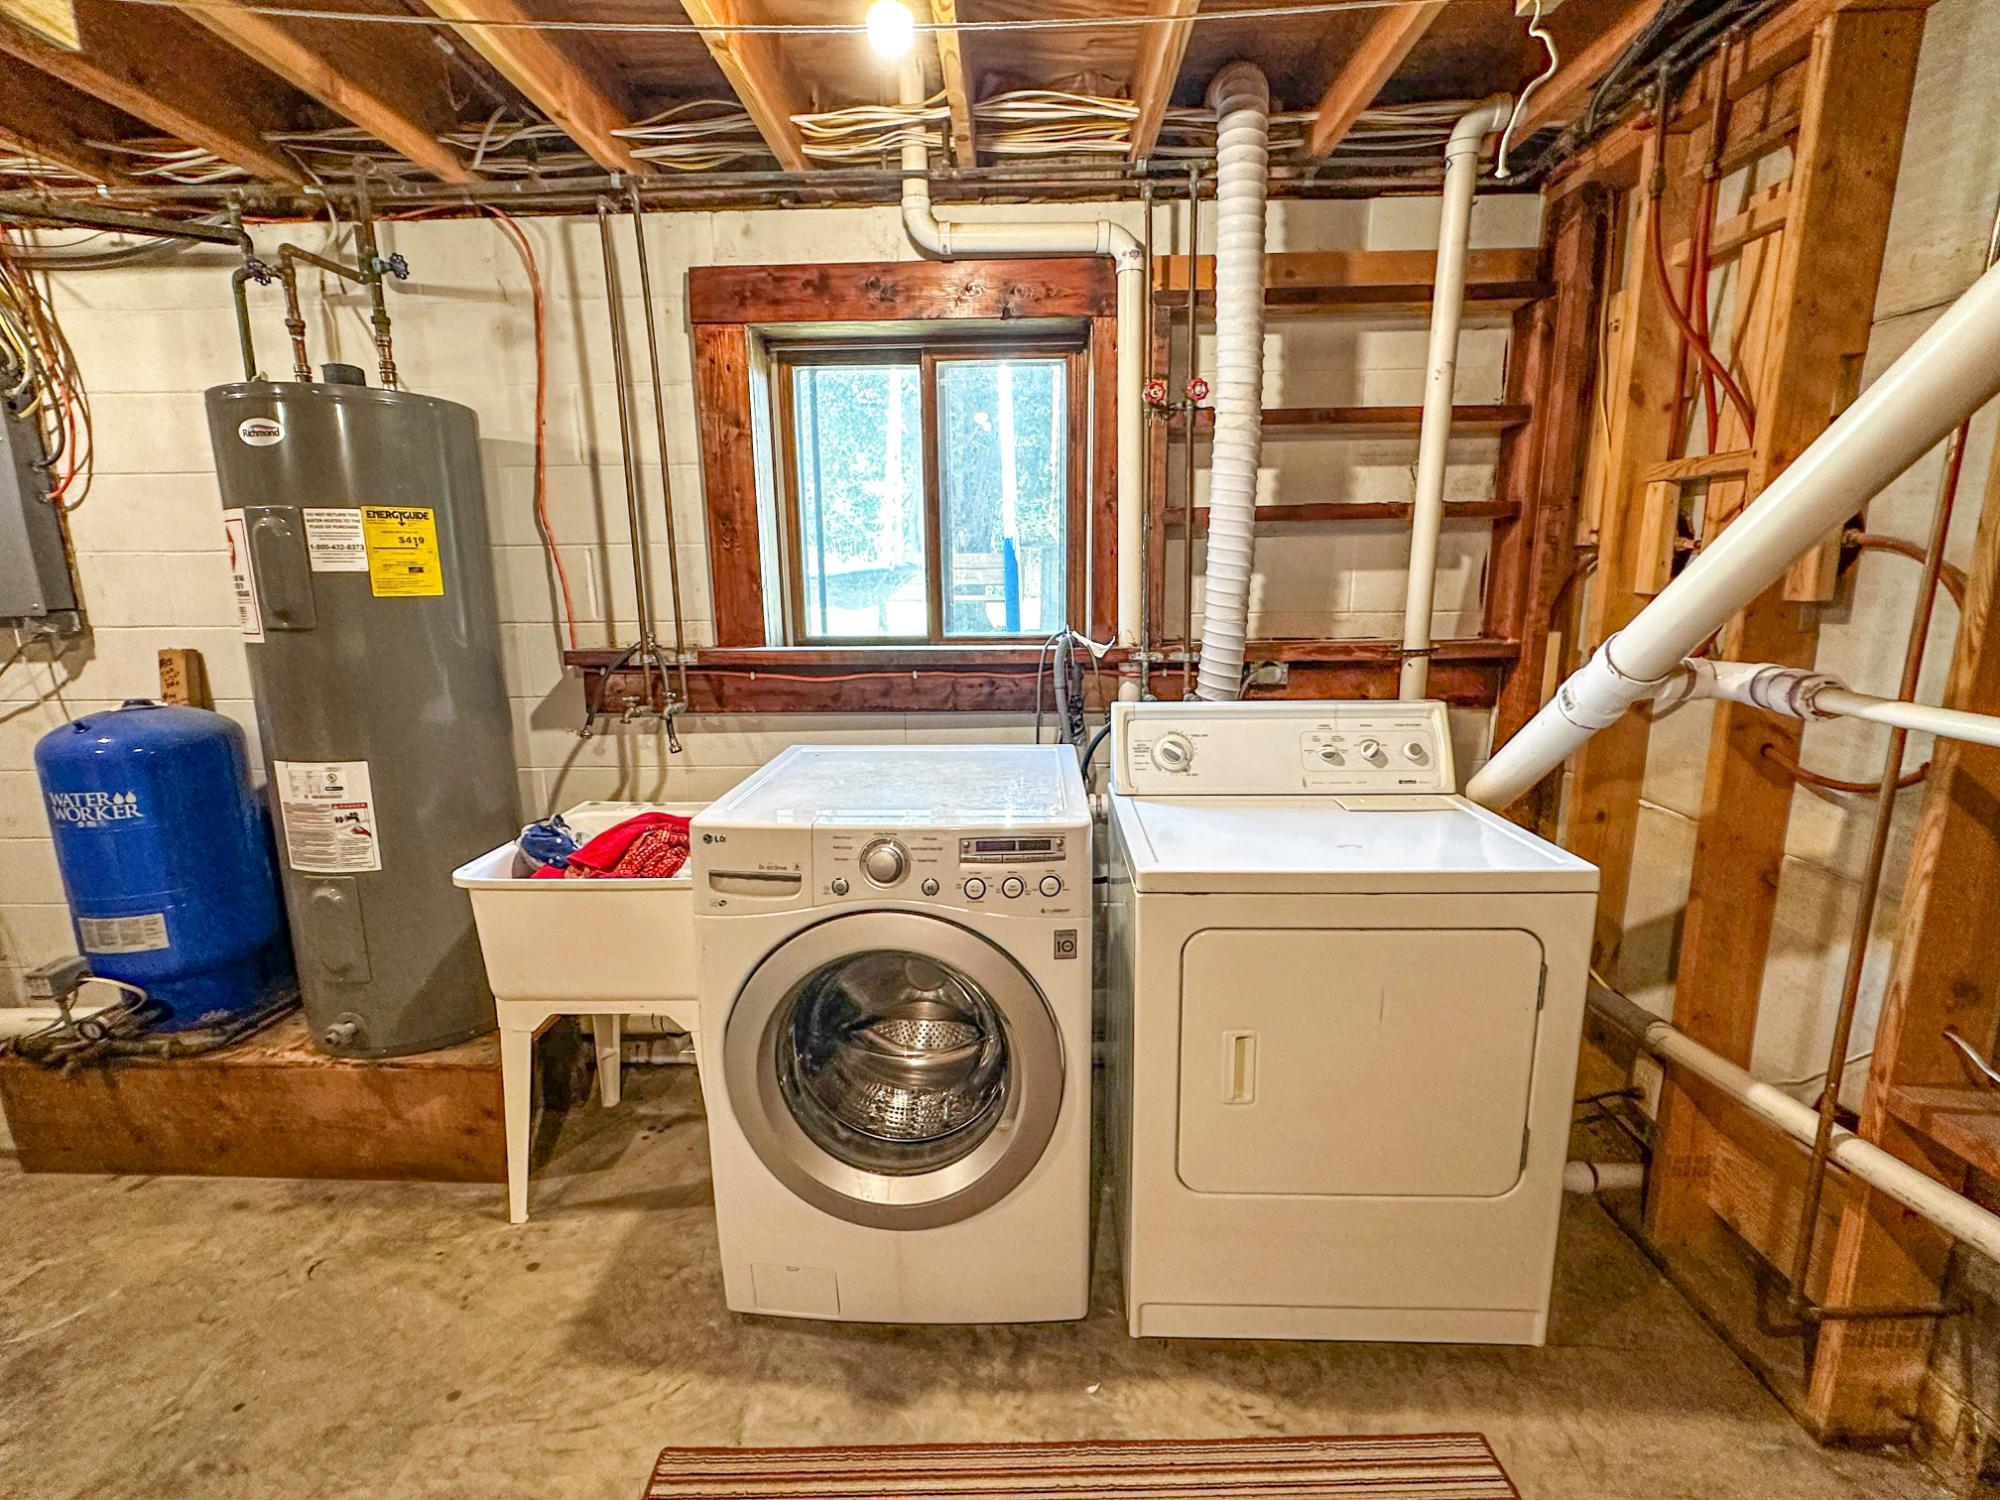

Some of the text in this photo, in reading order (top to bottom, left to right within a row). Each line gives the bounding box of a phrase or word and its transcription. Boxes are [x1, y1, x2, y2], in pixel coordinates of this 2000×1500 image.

[242, 427, 280, 438] Richmond
[366, 510, 430, 521] ENERGYGUIDE
[48, 791, 113, 808] WATER
[52, 803, 145, 822] WORKER
[714, 834, 727, 844] LG
